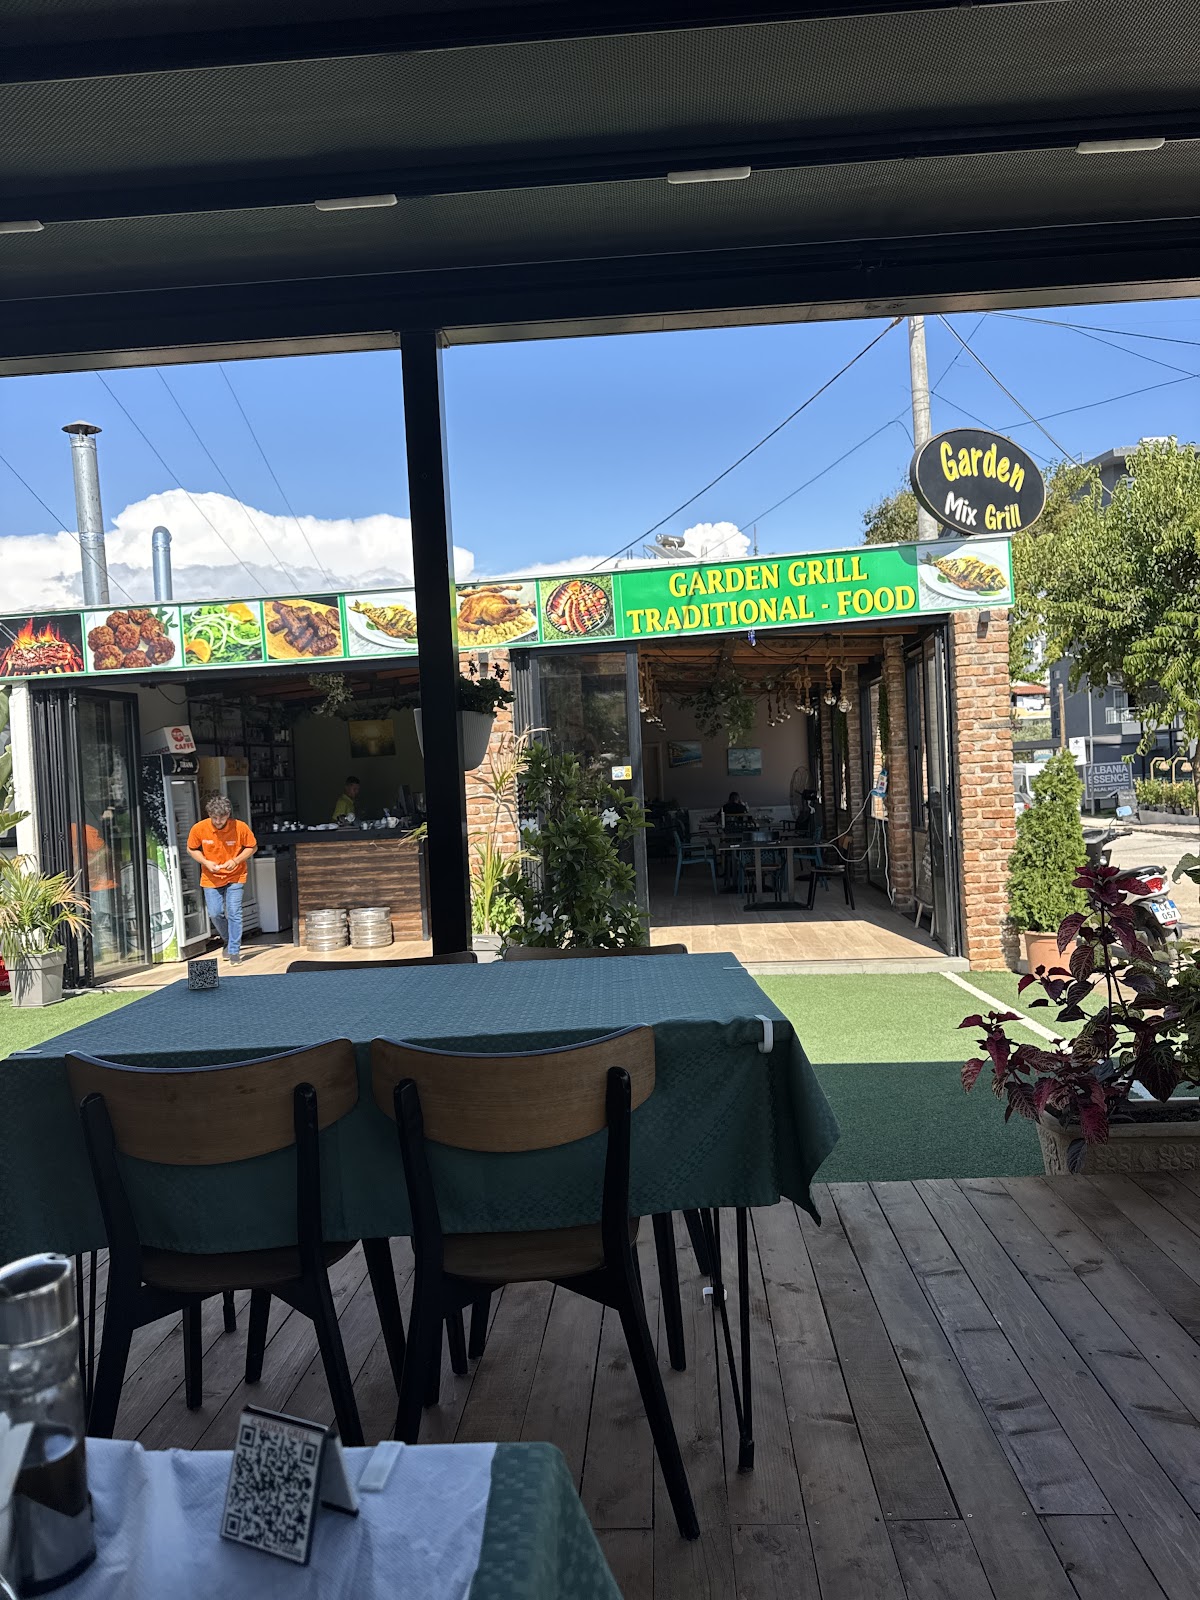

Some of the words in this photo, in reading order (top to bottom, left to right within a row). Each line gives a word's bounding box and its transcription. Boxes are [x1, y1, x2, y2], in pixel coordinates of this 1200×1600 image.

[940, 441, 1025, 493] Garden
[945, 491, 977, 526] Mix
[985, 503, 1022, 530] Grill
[668, 563, 781, 597] GARDEN
[788, 556, 868, 588] GRILL
[626, 595, 814, 634] TRADITIONAL
[837, 585, 916, 616] FOOD
[1088, 764, 1128, 775] ALBANIA
[1088, 773, 1129, 784] ESSENCE
